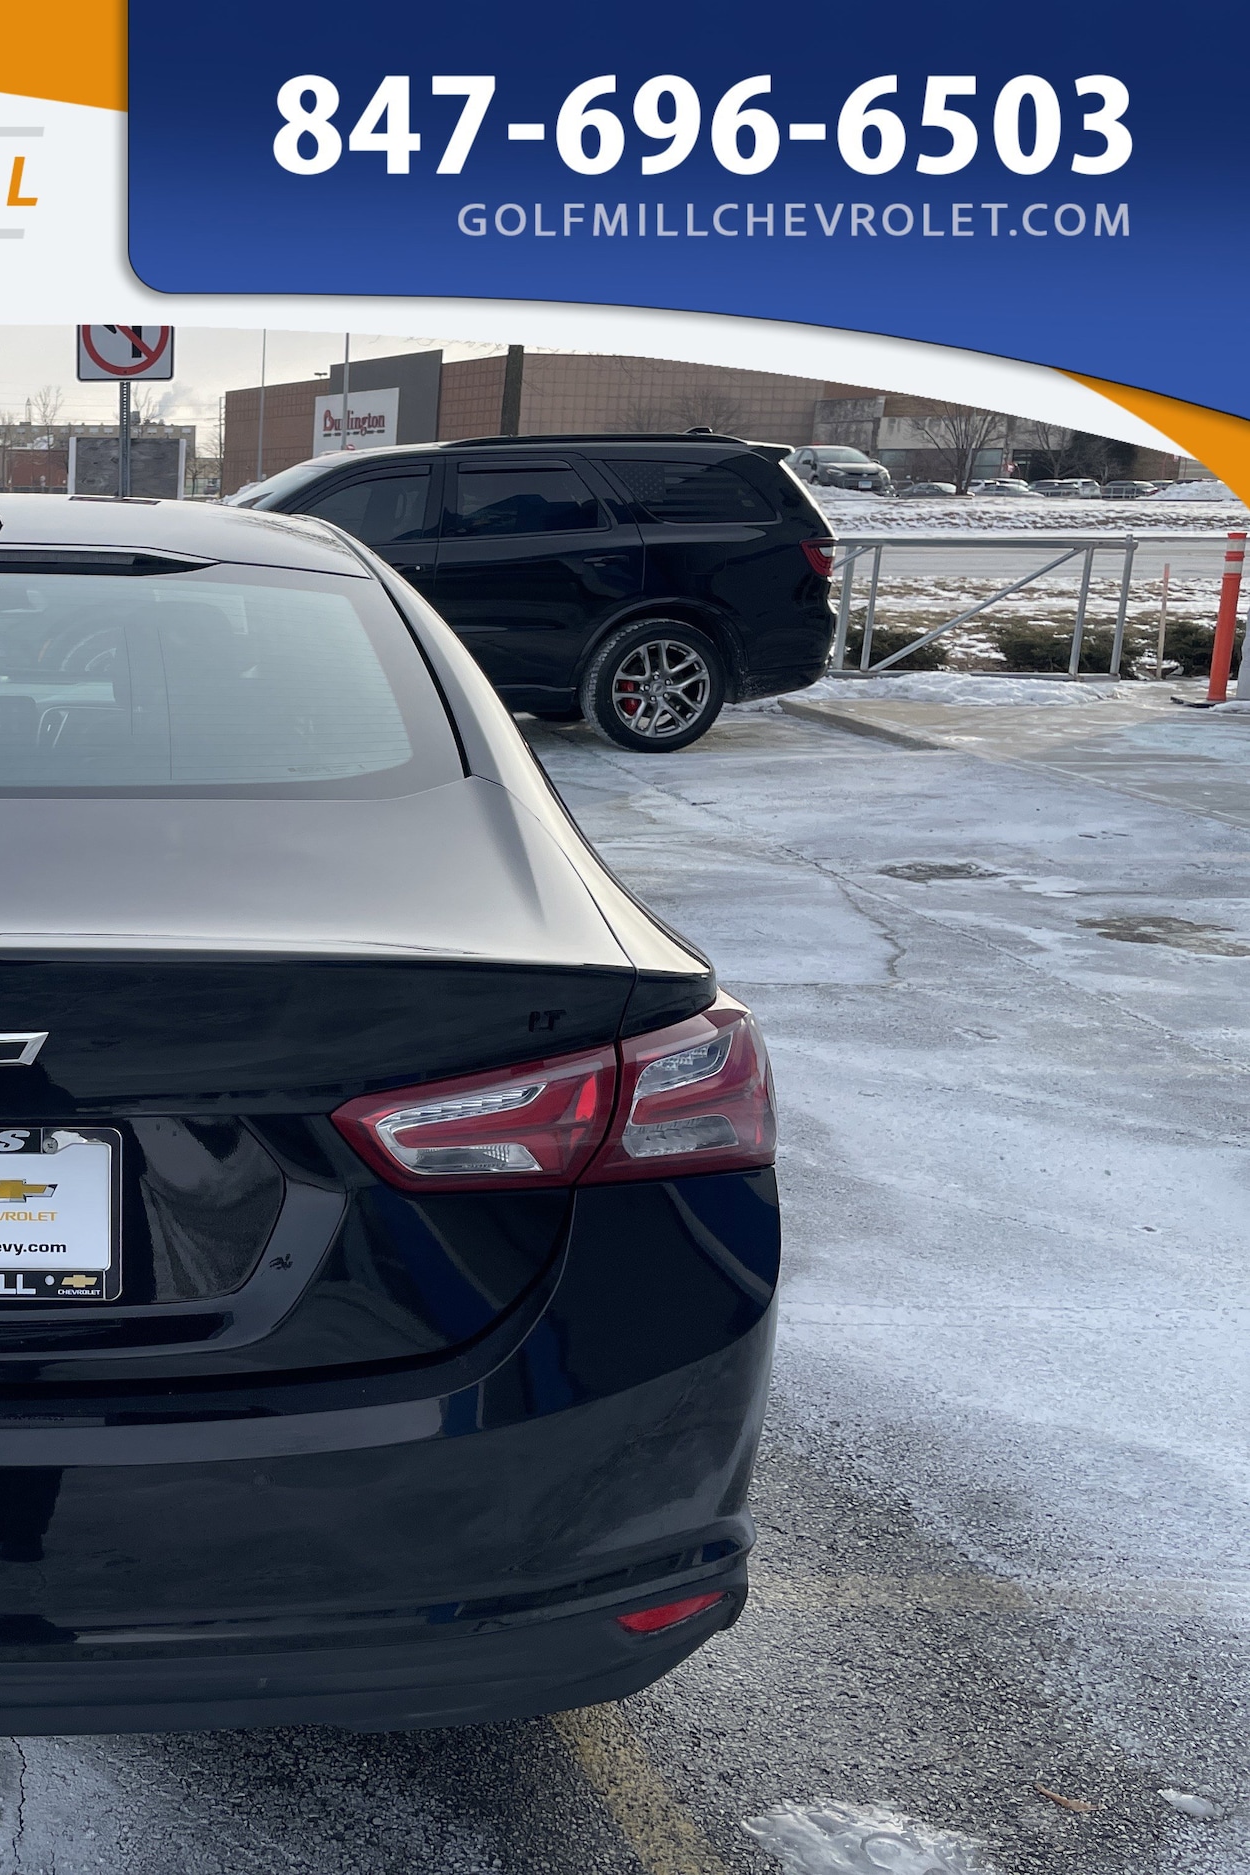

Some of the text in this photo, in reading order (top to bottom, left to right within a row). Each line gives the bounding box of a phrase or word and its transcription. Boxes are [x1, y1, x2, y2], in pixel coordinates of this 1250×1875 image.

[323, 409, 385, 437] Bulington
[529, 1009, 567, 1032] LT
[57, 1288, 101, 1296] CHEVROLET
